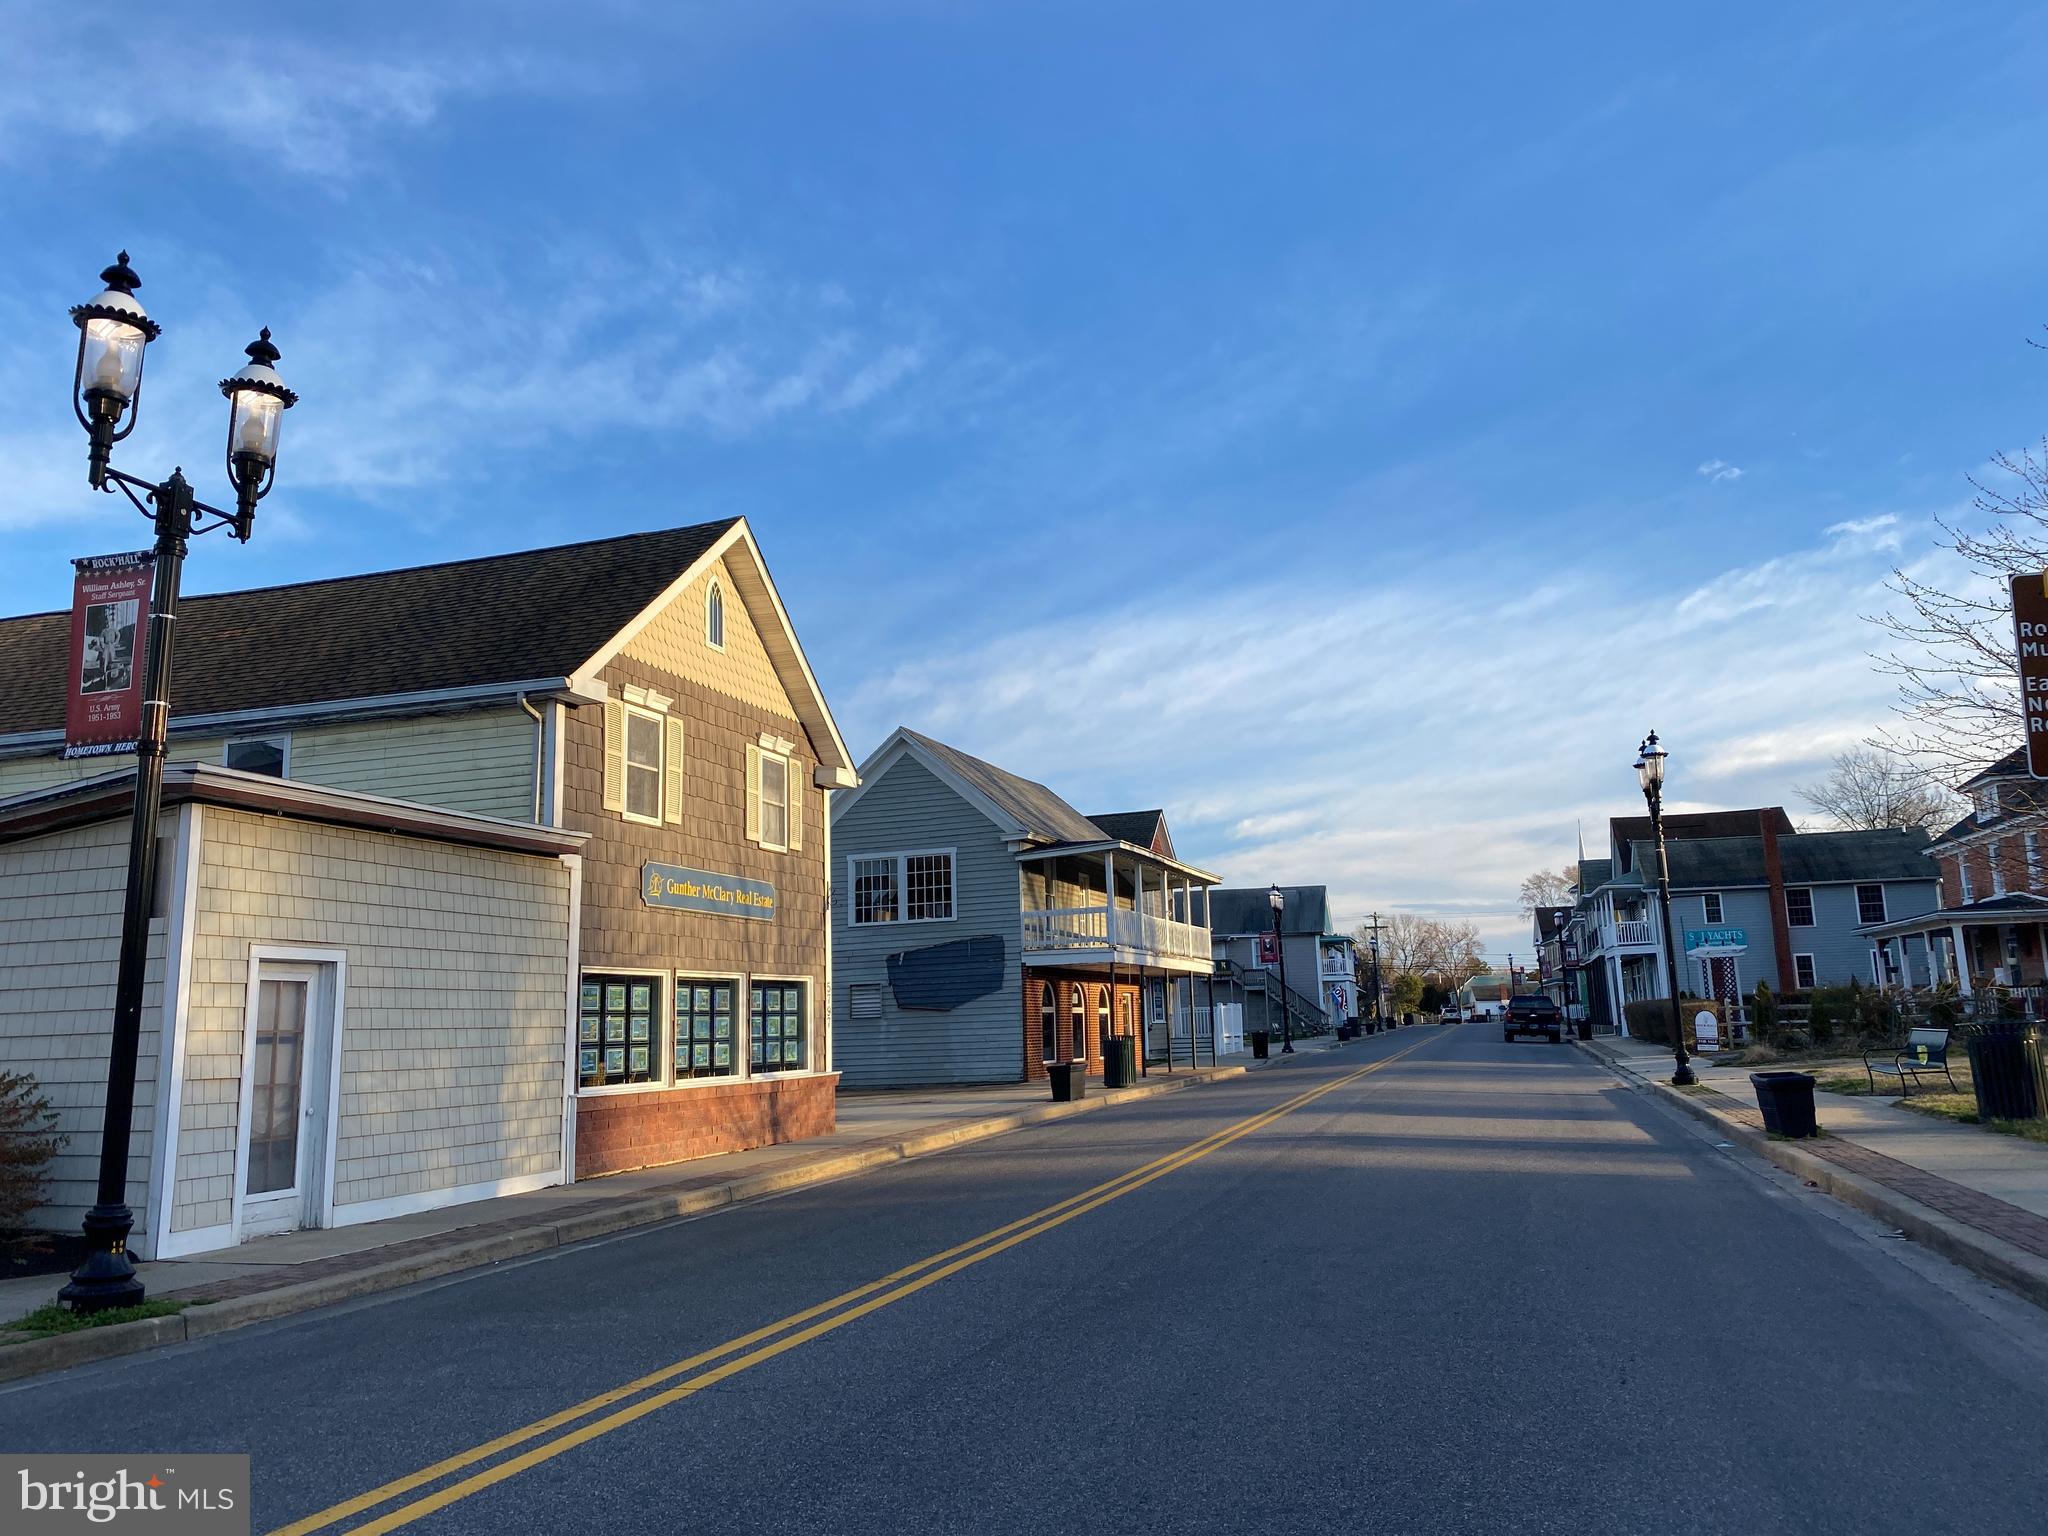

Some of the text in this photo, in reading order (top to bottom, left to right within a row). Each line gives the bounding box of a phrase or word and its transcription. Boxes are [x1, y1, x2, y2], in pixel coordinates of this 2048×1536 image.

[118, 554, 140, 566] HALL
[82, 583, 109, 593] William
[91, 590, 136, 601] Staff Sergeant
[103, 703, 121, 712] Army
[2028, 697, 2048, 712] N
[88, 711, 121, 722] 1951-1953
[2031, 717, 2048, 732] R
[64, 743, 113, 757] HOMETOWN
[666, 878, 774, 908] Gunther McClary Real Estate
[1707, 930, 1743, 940] YACHTS
